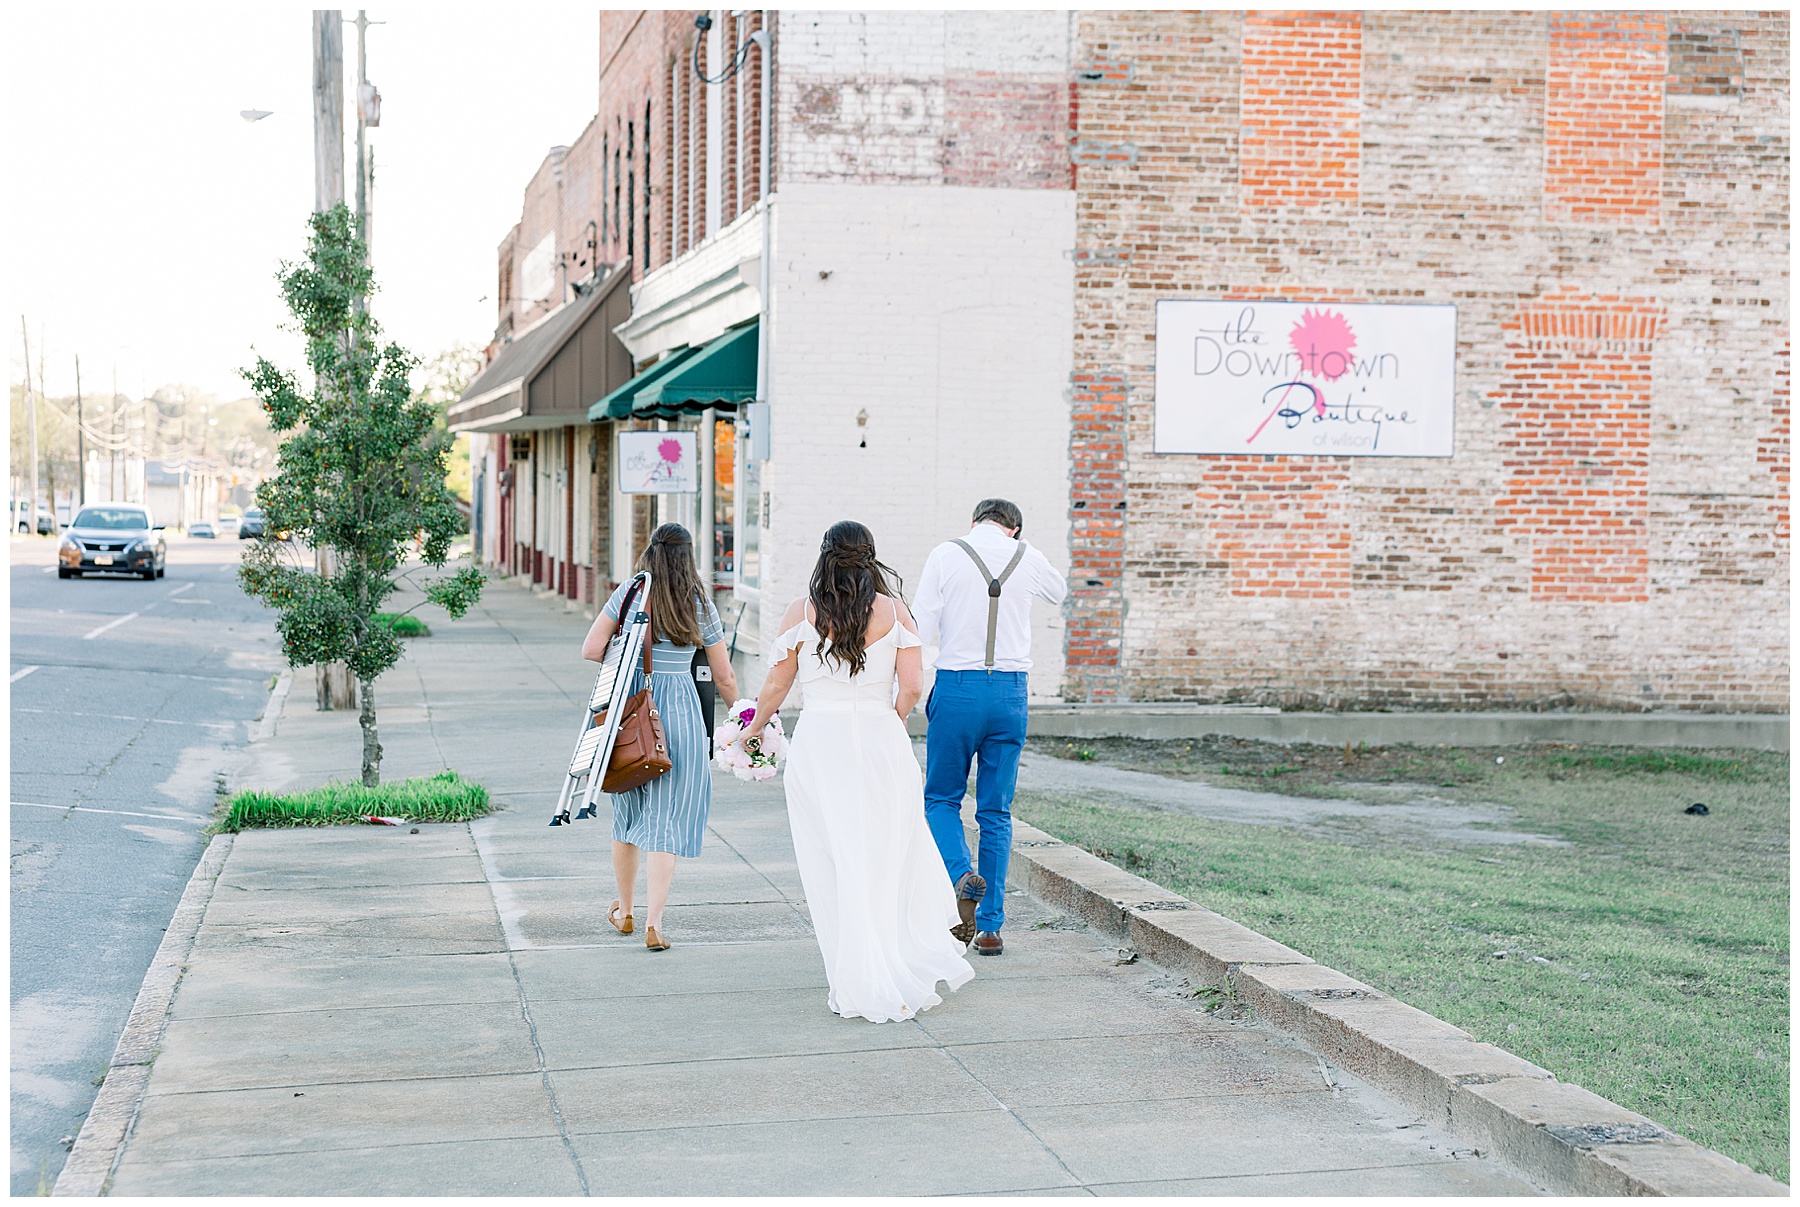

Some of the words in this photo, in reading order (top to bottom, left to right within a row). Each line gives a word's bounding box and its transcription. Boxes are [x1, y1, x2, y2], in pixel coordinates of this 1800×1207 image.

[1199, 306, 1268, 346] the
[1194, 336, 1399, 379] Downtown
[1262, 382, 1416, 450] Boutique
[1312, 432, 1328, 447] of
[1331, 434, 1372, 448] wilson
